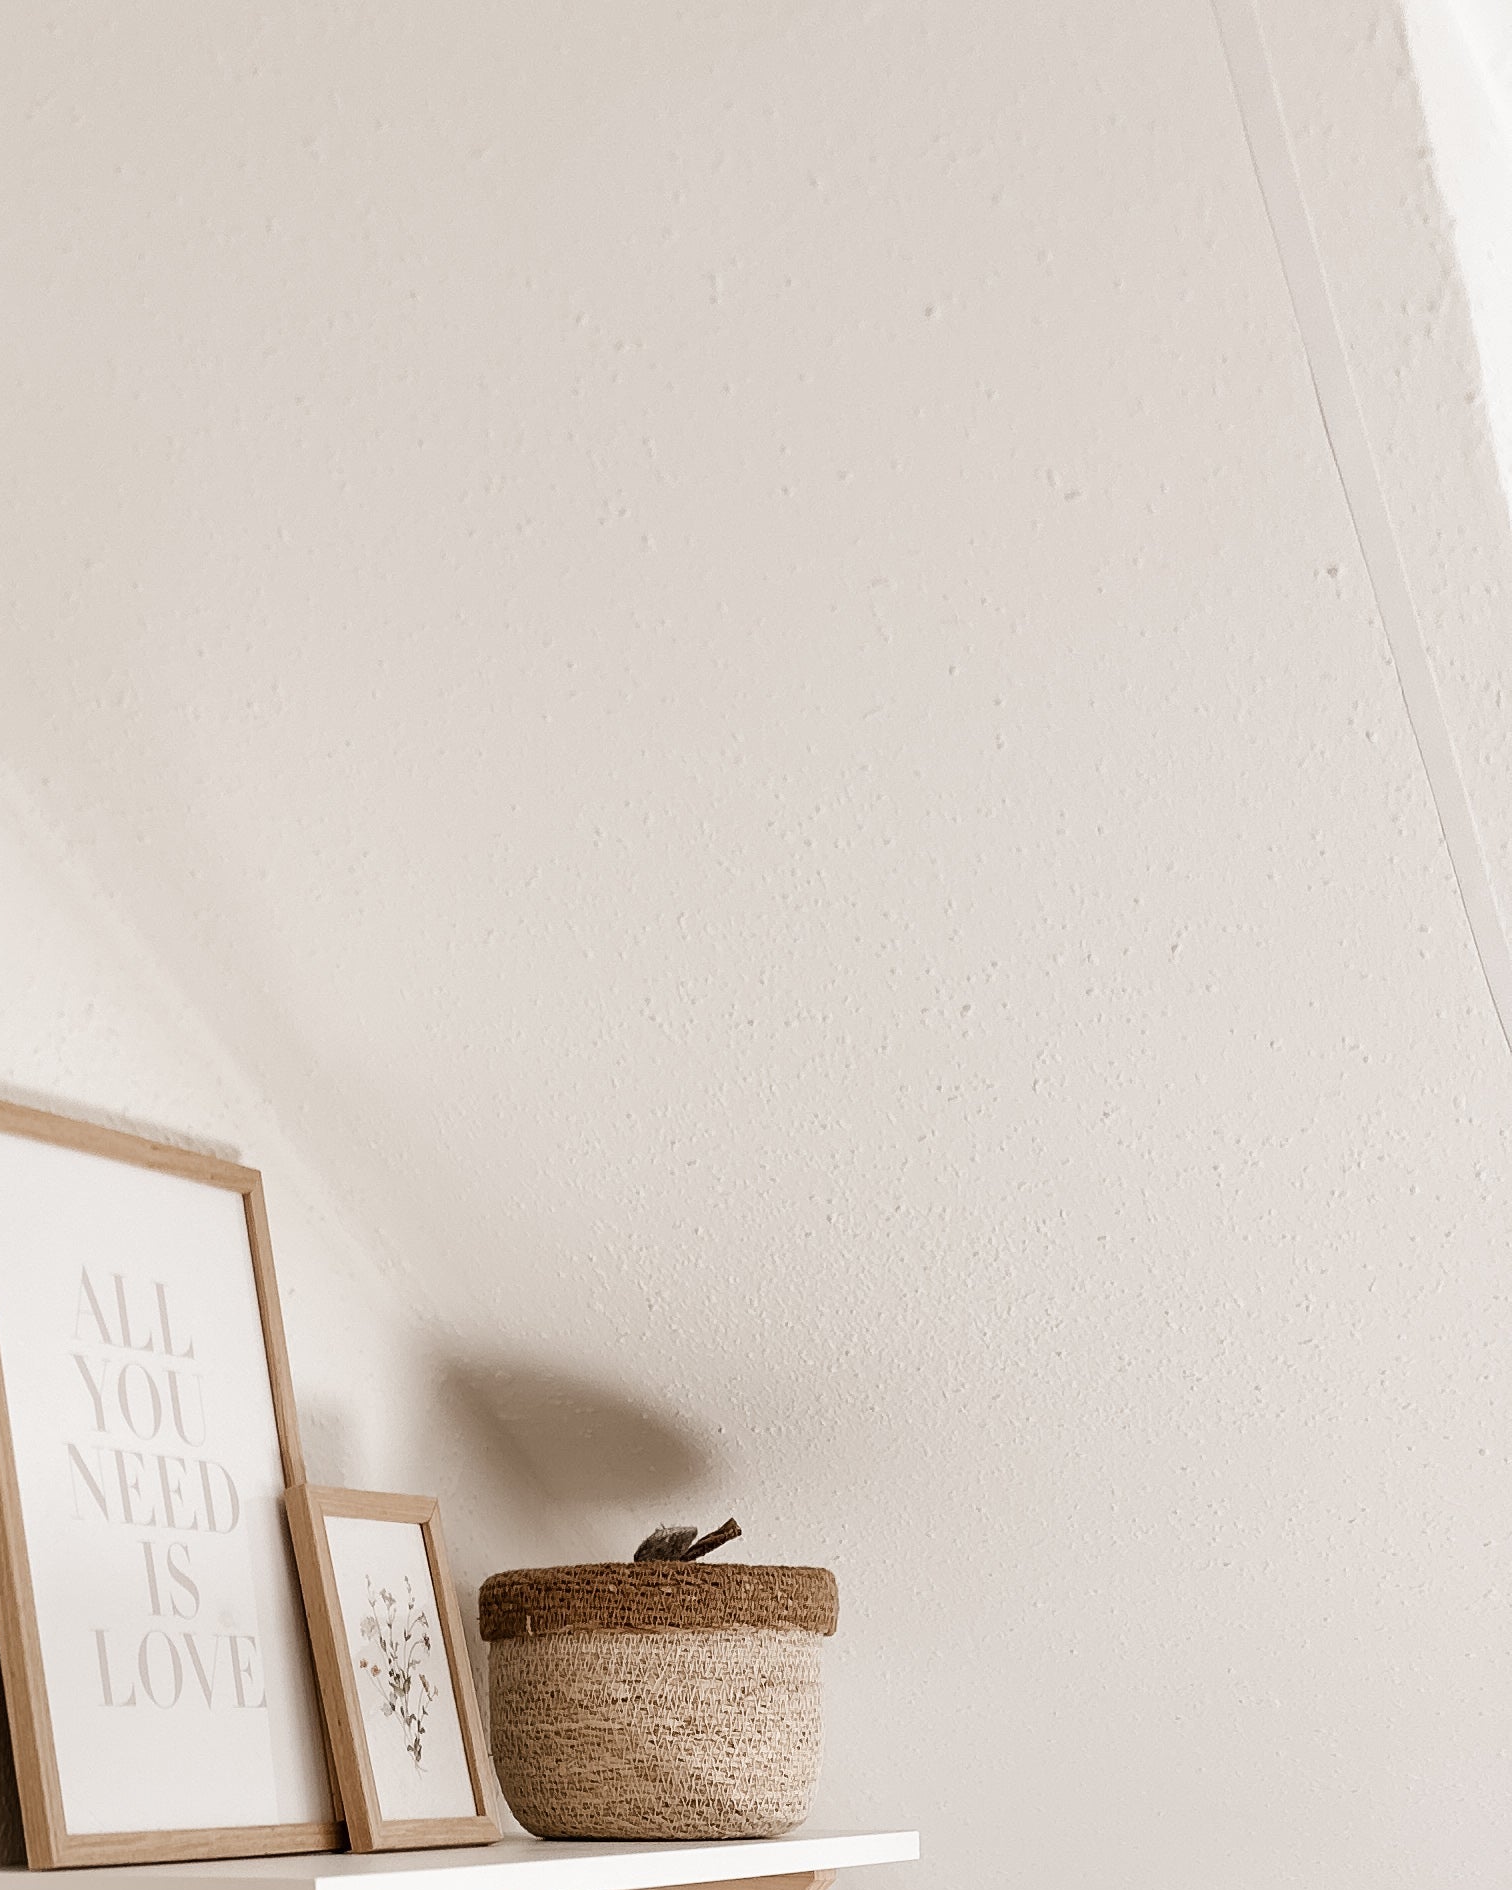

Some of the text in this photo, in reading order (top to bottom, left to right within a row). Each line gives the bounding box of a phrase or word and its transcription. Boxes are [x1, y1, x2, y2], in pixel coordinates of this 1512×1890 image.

[72, 1264, 195, 1360] ALL
[74, 1353, 207, 1450] YOU
[66, 1442, 242, 1536] NEED
[138, 1541, 201, 1619] IS
[90, 1629, 268, 1710] LOVE
